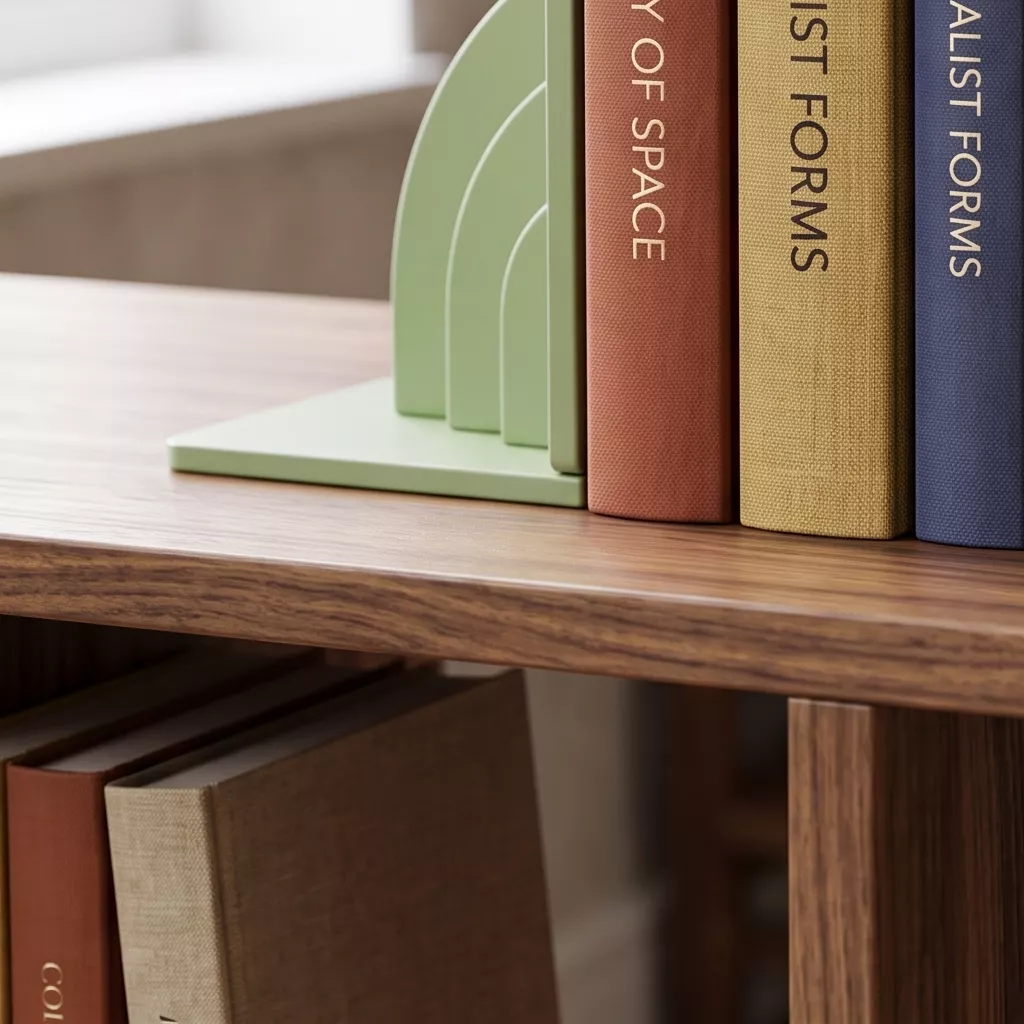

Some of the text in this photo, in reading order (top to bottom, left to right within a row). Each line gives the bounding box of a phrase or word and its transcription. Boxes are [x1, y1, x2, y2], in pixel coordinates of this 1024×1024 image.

[630, 37, 665, 102] OF
[631, 116, 666, 261] SPACE
[789, 92, 830, 273] FORMS
[948, 130, 982, 278] FORMS
